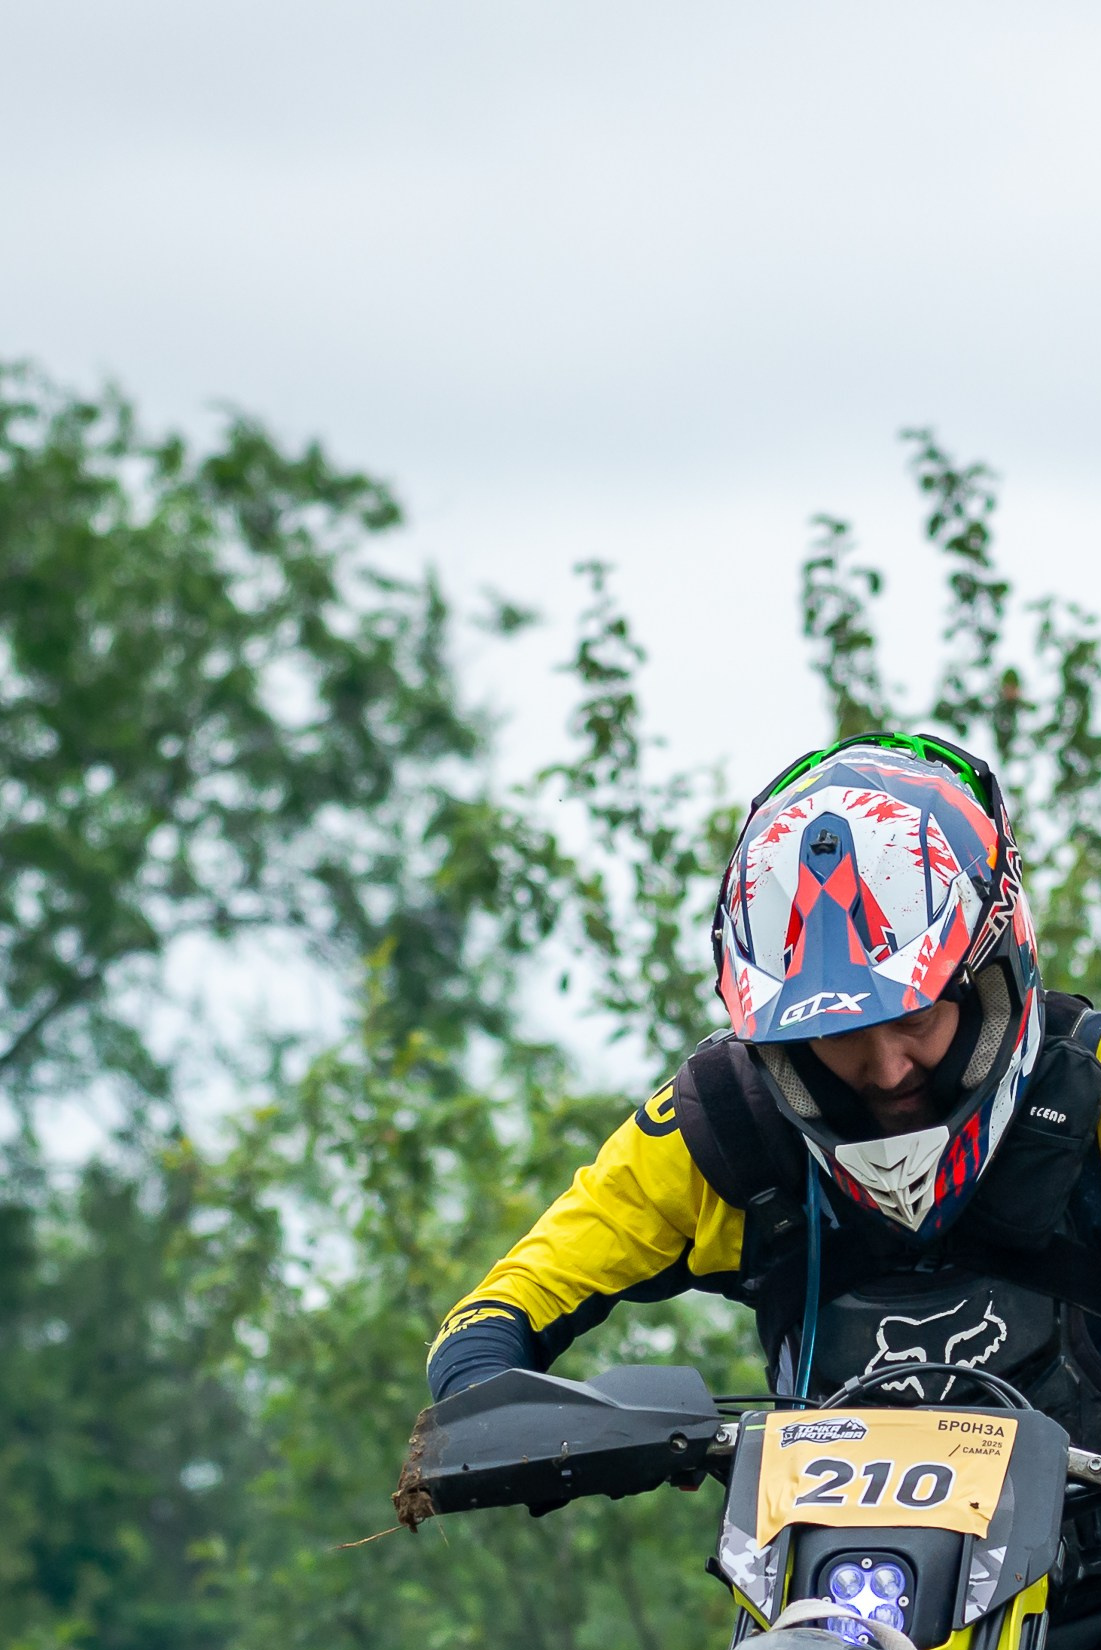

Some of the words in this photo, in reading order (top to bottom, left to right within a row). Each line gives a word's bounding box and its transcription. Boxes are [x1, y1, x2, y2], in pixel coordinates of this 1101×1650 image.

[780, 992, 872, 1027] GTX
[797, 1424, 842, 1434] ТОЧКА
[937, 1419, 1005, 1438] БРОНЗА
[962, 1446, 1001, 1457] САМАРА
[981, 1439, 1003, 1449] 2025
[795, 1458, 954, 1508] 210
